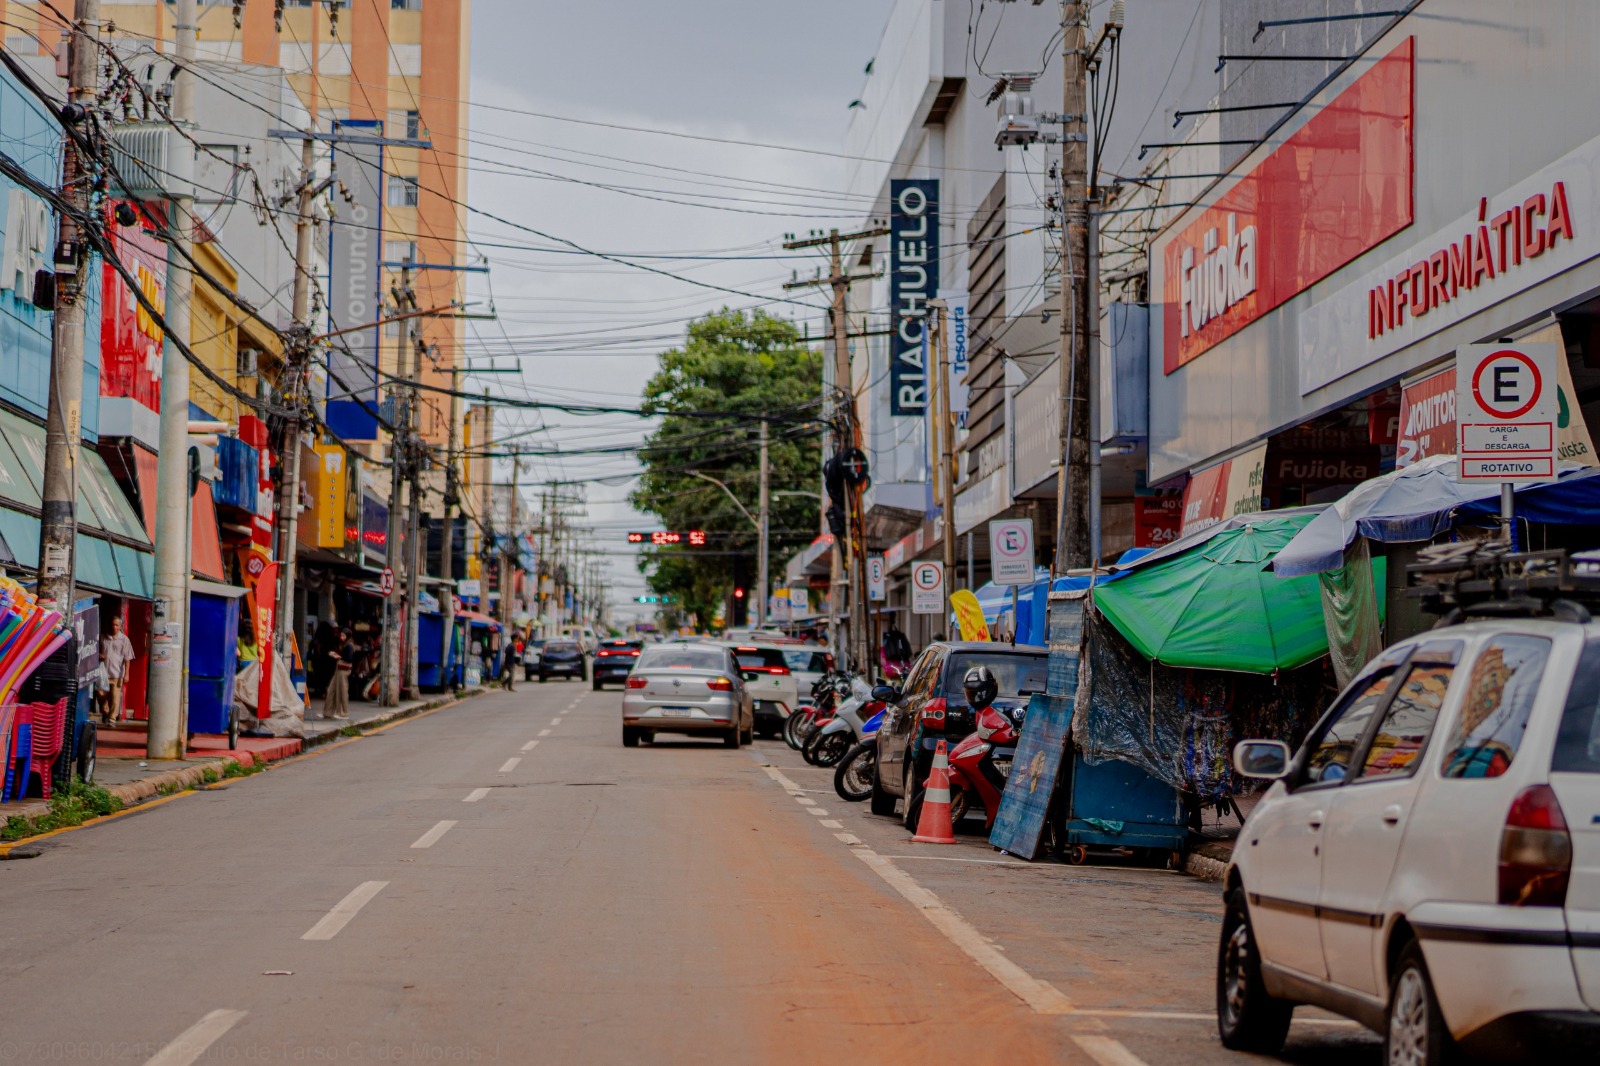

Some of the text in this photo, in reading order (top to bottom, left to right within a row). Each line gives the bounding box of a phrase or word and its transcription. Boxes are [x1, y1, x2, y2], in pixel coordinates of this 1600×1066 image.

[1368, 181, 1573, 339] INFORMÁTICA
[1181, 213, 1257, 338] Fujioka
[898, 186, 928, 409] RIACHUELO
[953, 306, 967, 374] Tesoura
[1493, 366, 1520, 402] E
[1484, 442, 1531, 450] DESCARGA
[1557, 441, 1588, 458] vista
[1279, 459, 1368, 479] Fujioka
[1480, 463, 1534, 473] ROTATIVO
[922, 569, 934, 584] E
